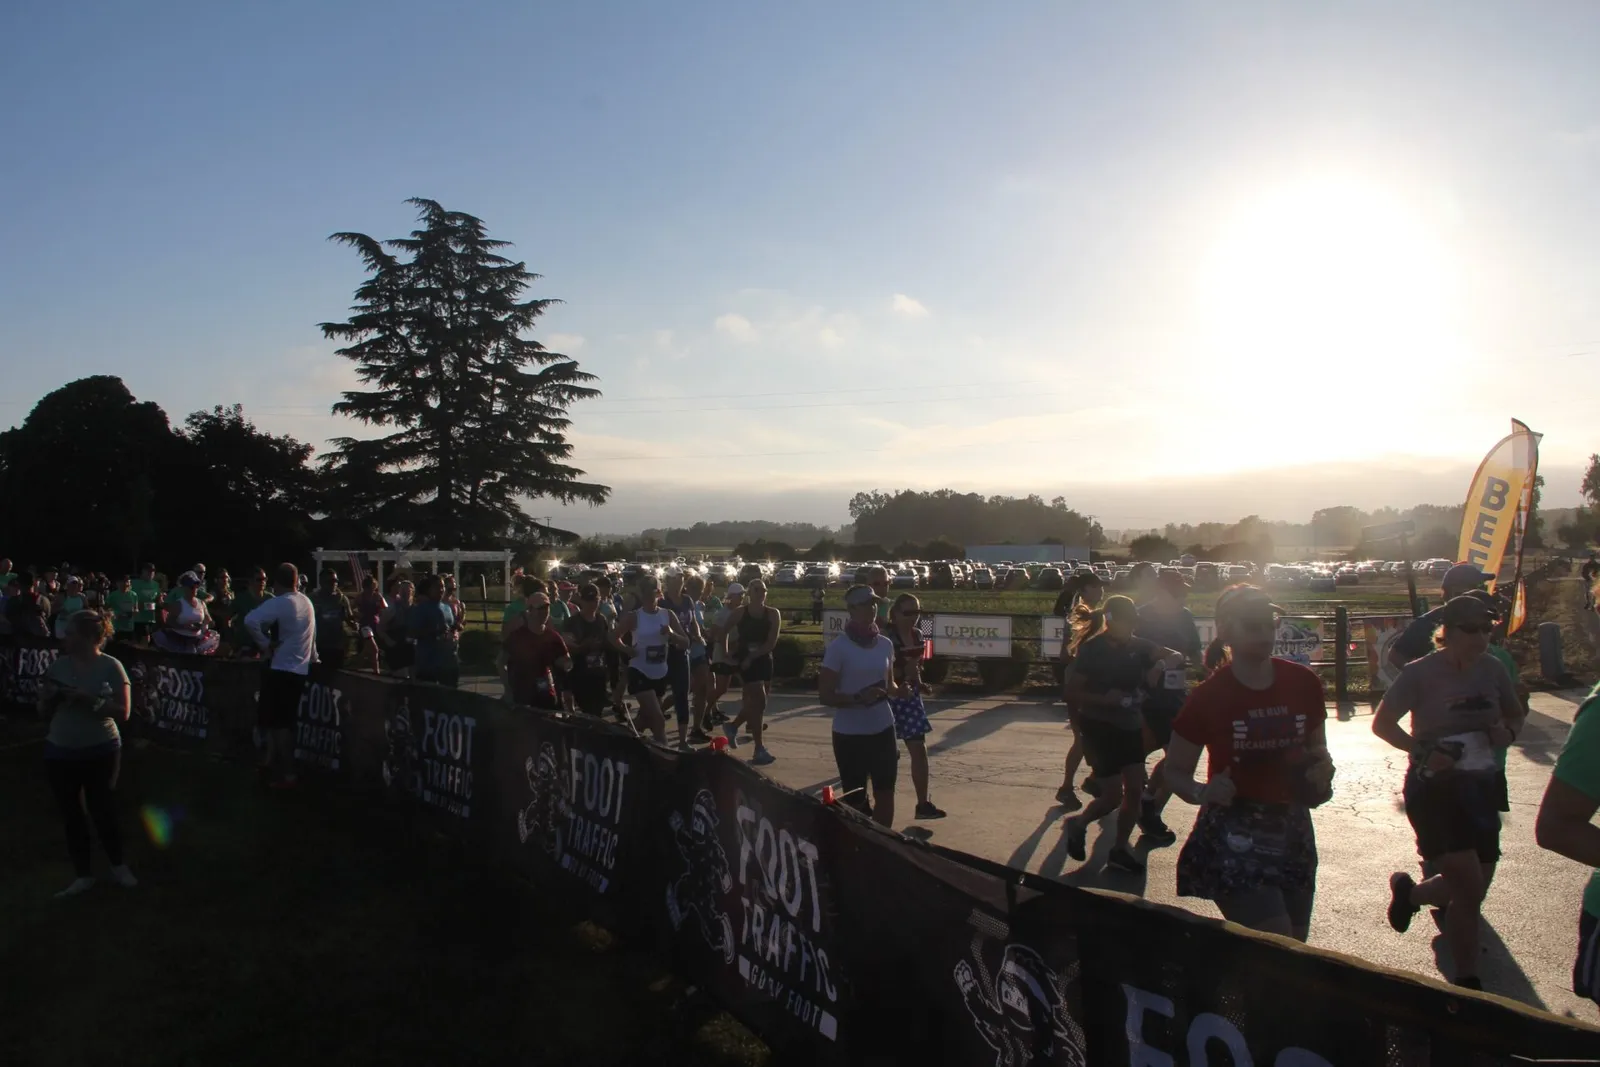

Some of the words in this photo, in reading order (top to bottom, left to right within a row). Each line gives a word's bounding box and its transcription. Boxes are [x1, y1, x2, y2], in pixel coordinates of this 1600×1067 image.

[944, 625, 999, 638] U-PICK
[157, 664, 204, 703] FOOT
[297, 680, 342, 727] FOOT
[296, 721, 342, 755] TRAFFIC
[421, 708, 477, 767] FOOT
[424, 757, 474, 801] TRAFFIC
[569, 747, 629, 825] FOOT
[567, 811, 619, 871] TRAFFIC
[736, 803, 821, 933] FOOT
[740, 896, 838, 1003] TRAFFIC
[785, 989, 821, 1028] FOOT
